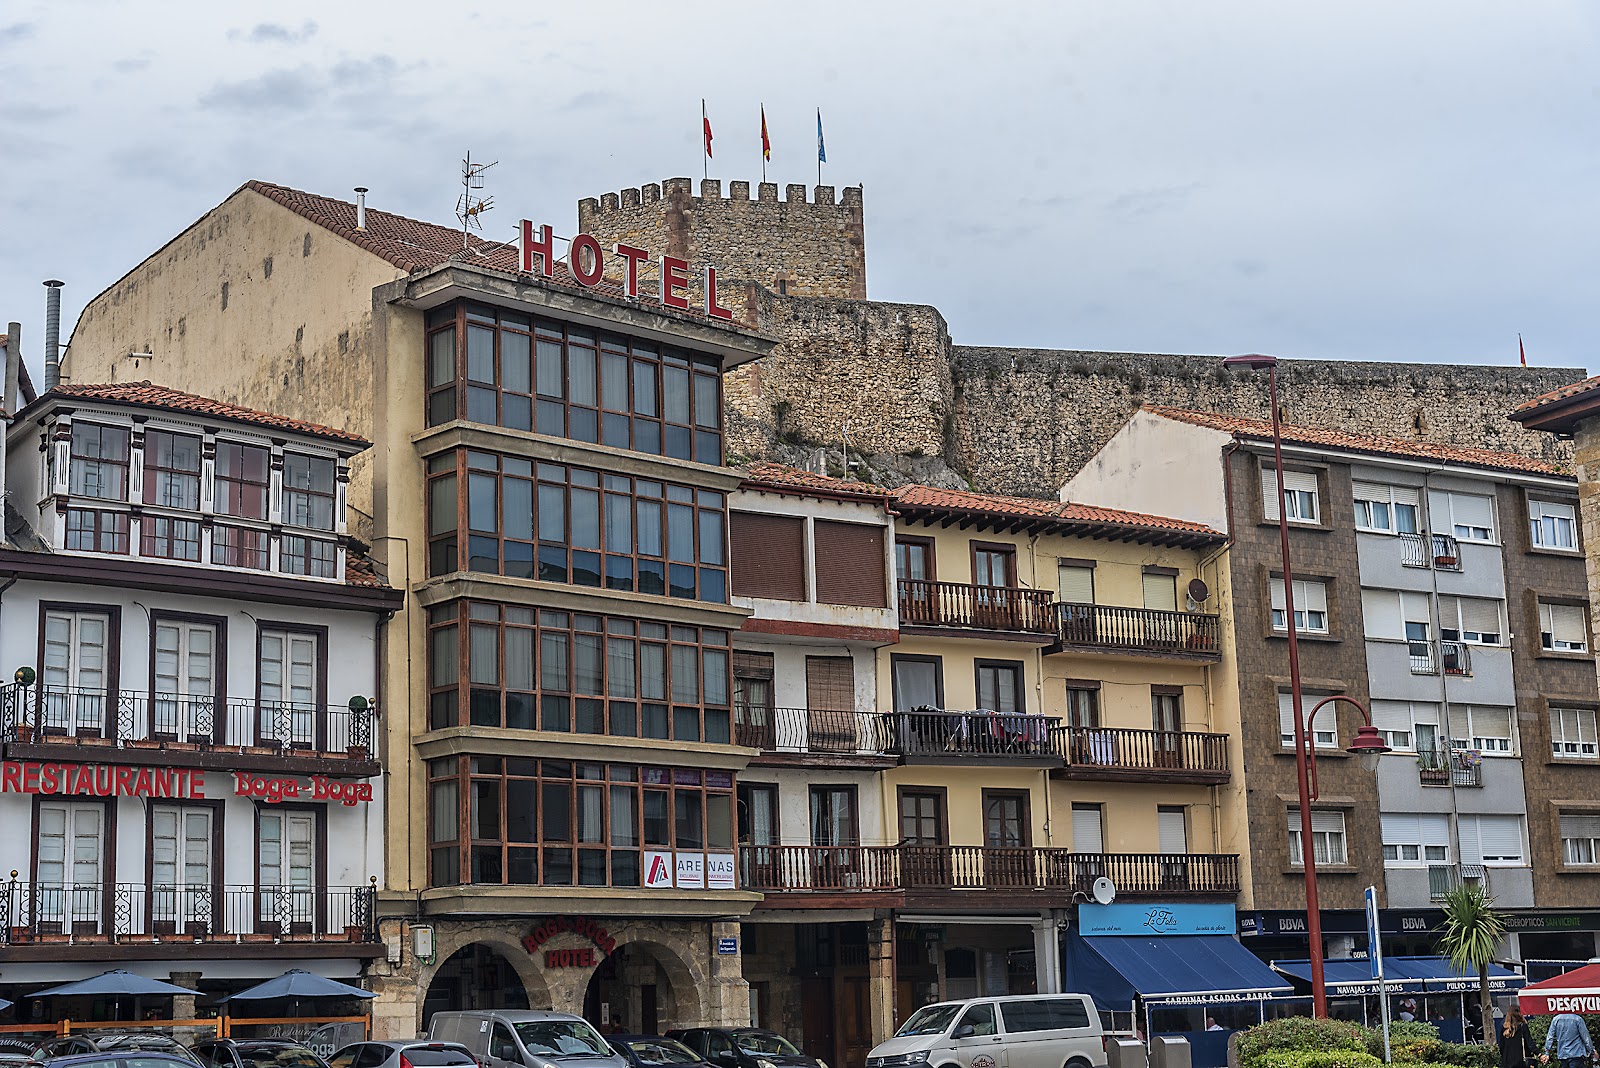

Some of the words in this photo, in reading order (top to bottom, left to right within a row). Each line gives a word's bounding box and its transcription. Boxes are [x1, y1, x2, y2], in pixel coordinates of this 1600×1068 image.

[518, 218, 733, 321] HOTEL
[1, 760, 206, 800] RESTAURANTE
[231, 771, 374, 807] Boga-Boga
[677, 860, 733, 872] ARENAS
[1279, 918, 1305, 931] BBVA
[1402, 917, 1427, 930] BBVA
[546, 948, 597, 968] HOTEL
[1336, 985, 1366, 995] NAVAJAS
[1371, 984, 1404, 993] ANHOAS
[1446, 982, 1466, 990] PULPO
[1208, 993, 1241, 1004] ASADAS
